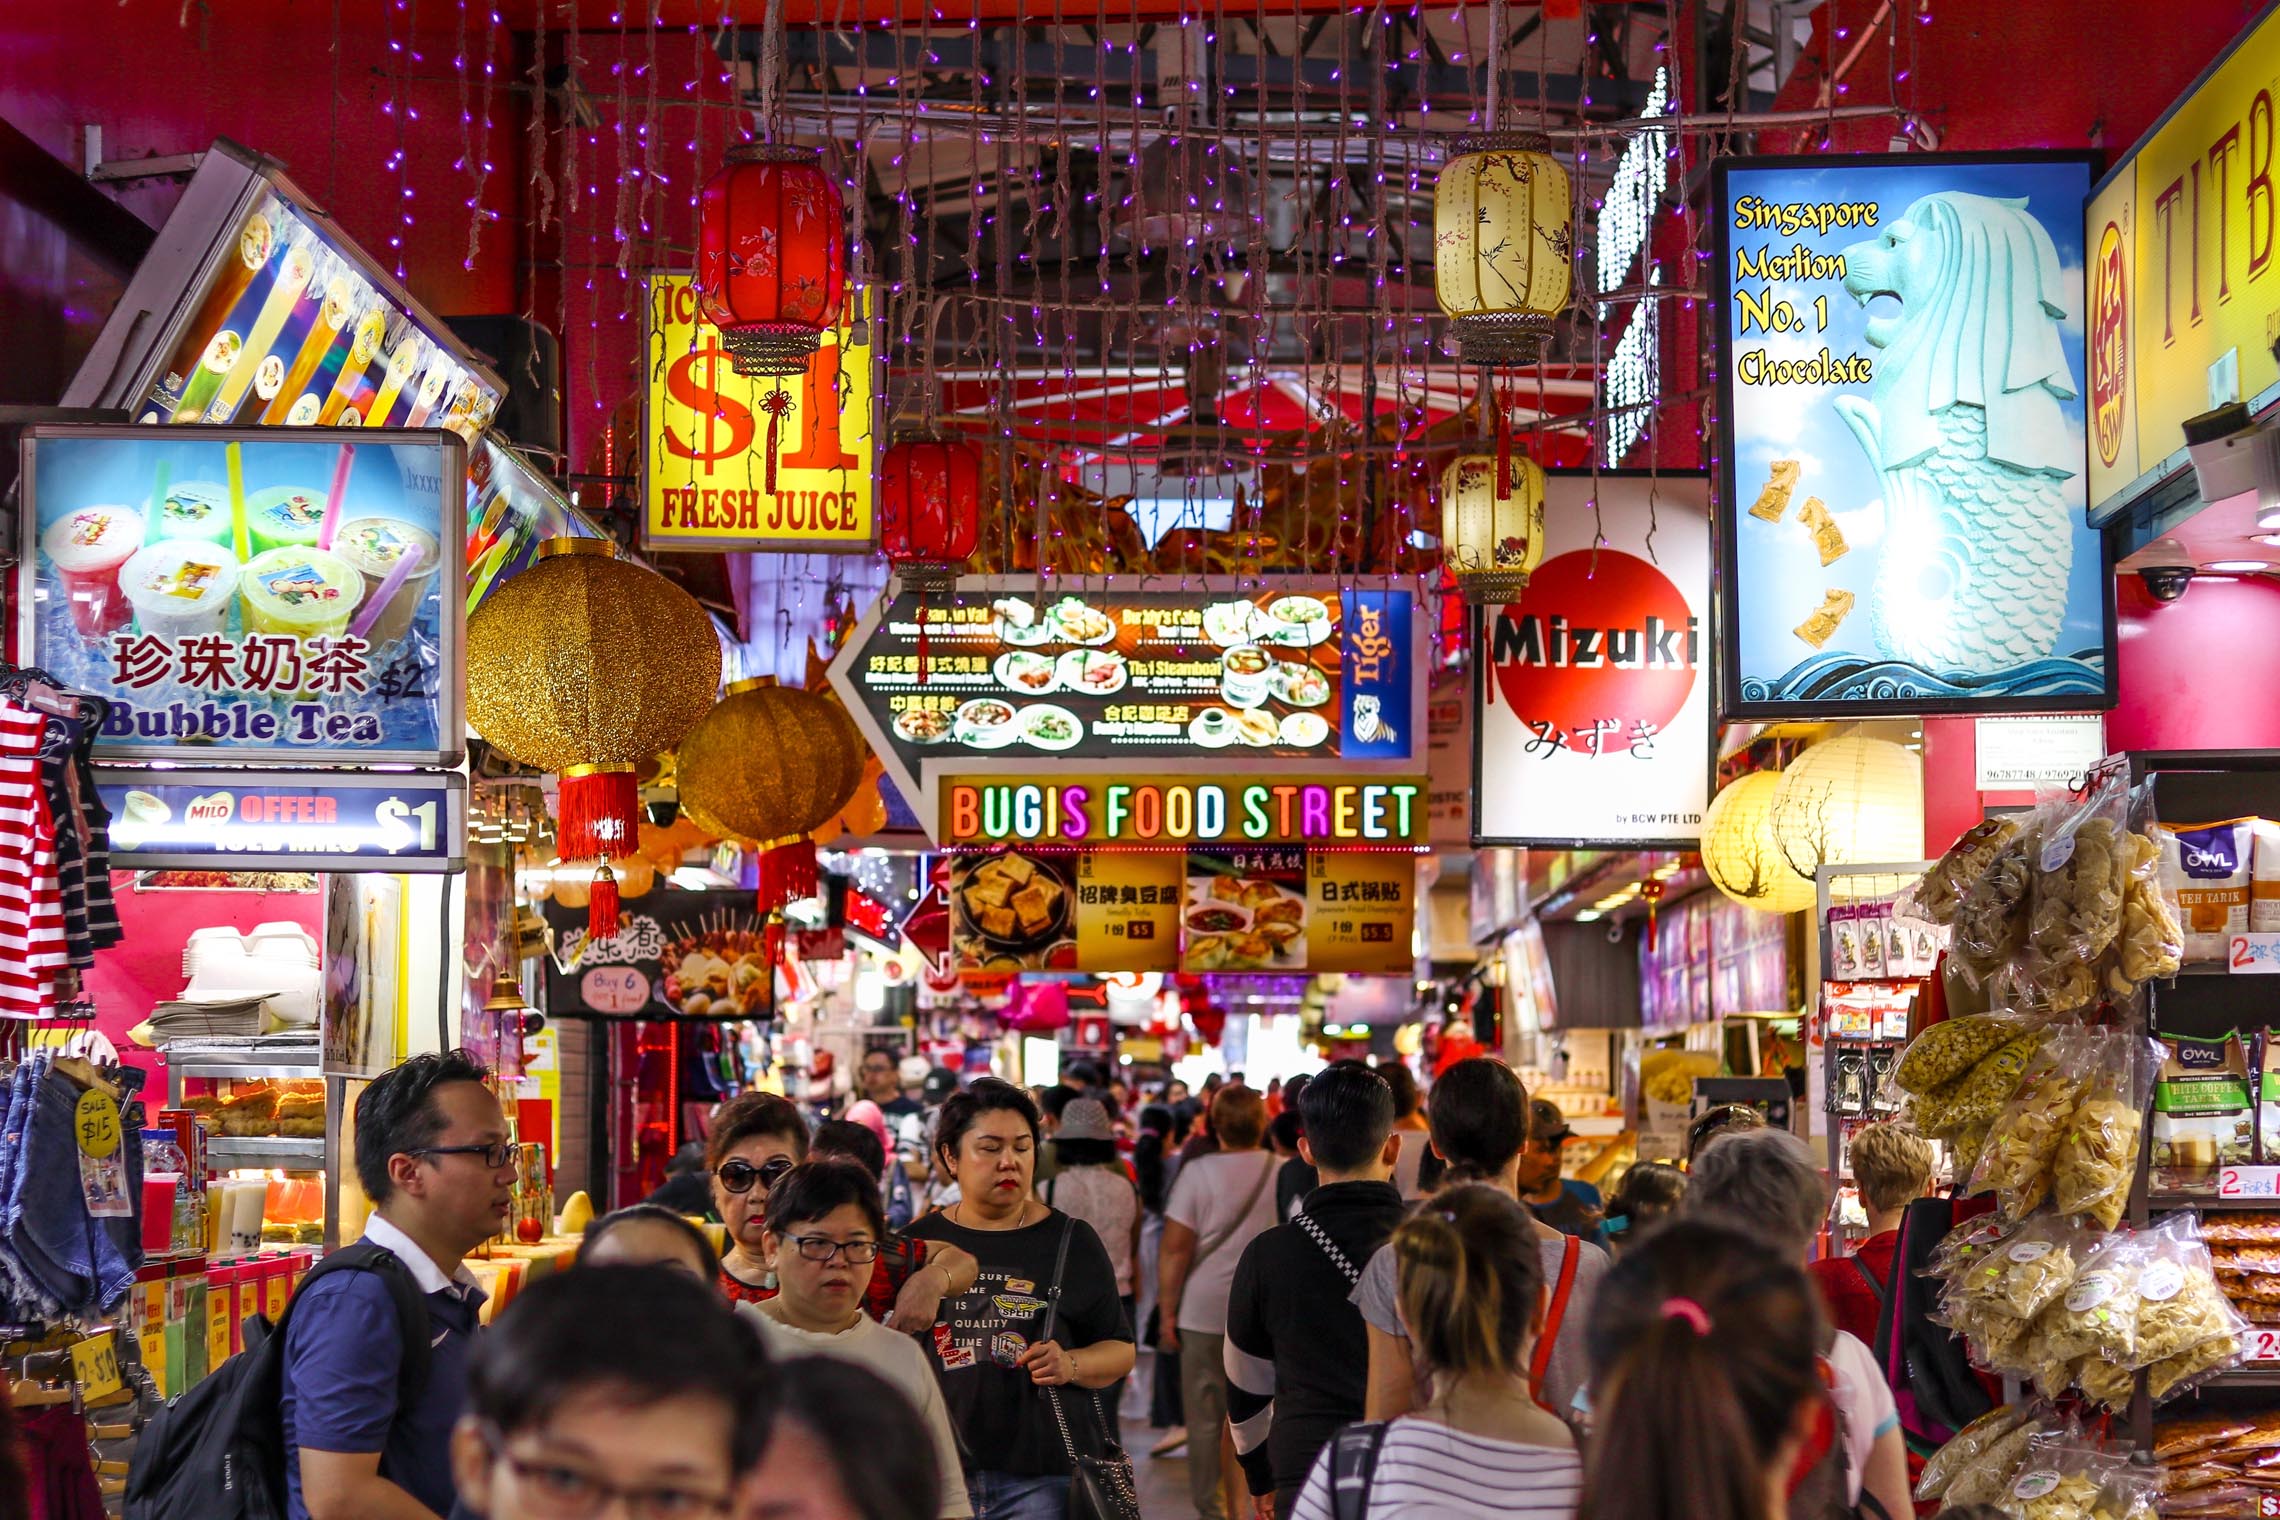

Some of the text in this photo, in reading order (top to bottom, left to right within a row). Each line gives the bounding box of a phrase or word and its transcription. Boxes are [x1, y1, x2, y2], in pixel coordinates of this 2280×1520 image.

[1734, 195, 1880, 237] Singapore
[1735, 242, 1848, 282] Merlion
[1734, 288, 1828, 335] No. 1
[1737, 347, 1873, 386] Chocolate
[665, 336, 859, 476] $1
[661, 488, 858, 531] FRESH JUICE
[1352, 604, 1392, 686] Tiger
[1493, 614, 1699, 668] Mizuki
[111, 634, 368, 694] 珍珠奶茶
[379, 662, 425, 704] $2
[102, 701, 381, 741] Bubble Tea
[1524, 718, 1659, 761] みずき
[1986, 769, 2036, 779] 96787748
[190, 795, 337, 823] MILO OFFER
[952, 784, 1418, 839] BUGIS FOOD STREET
[1616, 813, 1701, 825] by BCW PTE LTD
[374, 796, 437, 855] $1
[2186, 849, 2233, 867] OWL
[1079, 885, 1178, 905] 招牌臭豆腐
[1321, 881, 1401, 901] 日式锅贴
[2180, 891, 2240, 905] TEH TARIK
[1132, 924, 1150, 937] $5
[2231, 936, 2255, 967] 2
[594, 971, 636, 992] Buy 6
[2181, 1048, 2221, 1061] OWL
[81, 1098, 107, 1115] SALE
[81, 1116, 113, 1146] $15
[2222, 1170, 2241, 1194] 2
[955, 1301, 967, 1310] IS
[954, 1319, 1008, 1329] QUALITY
[954, 1338, 983, 1347] TIME
[2257, 1332, 2280, 1358] 2.
